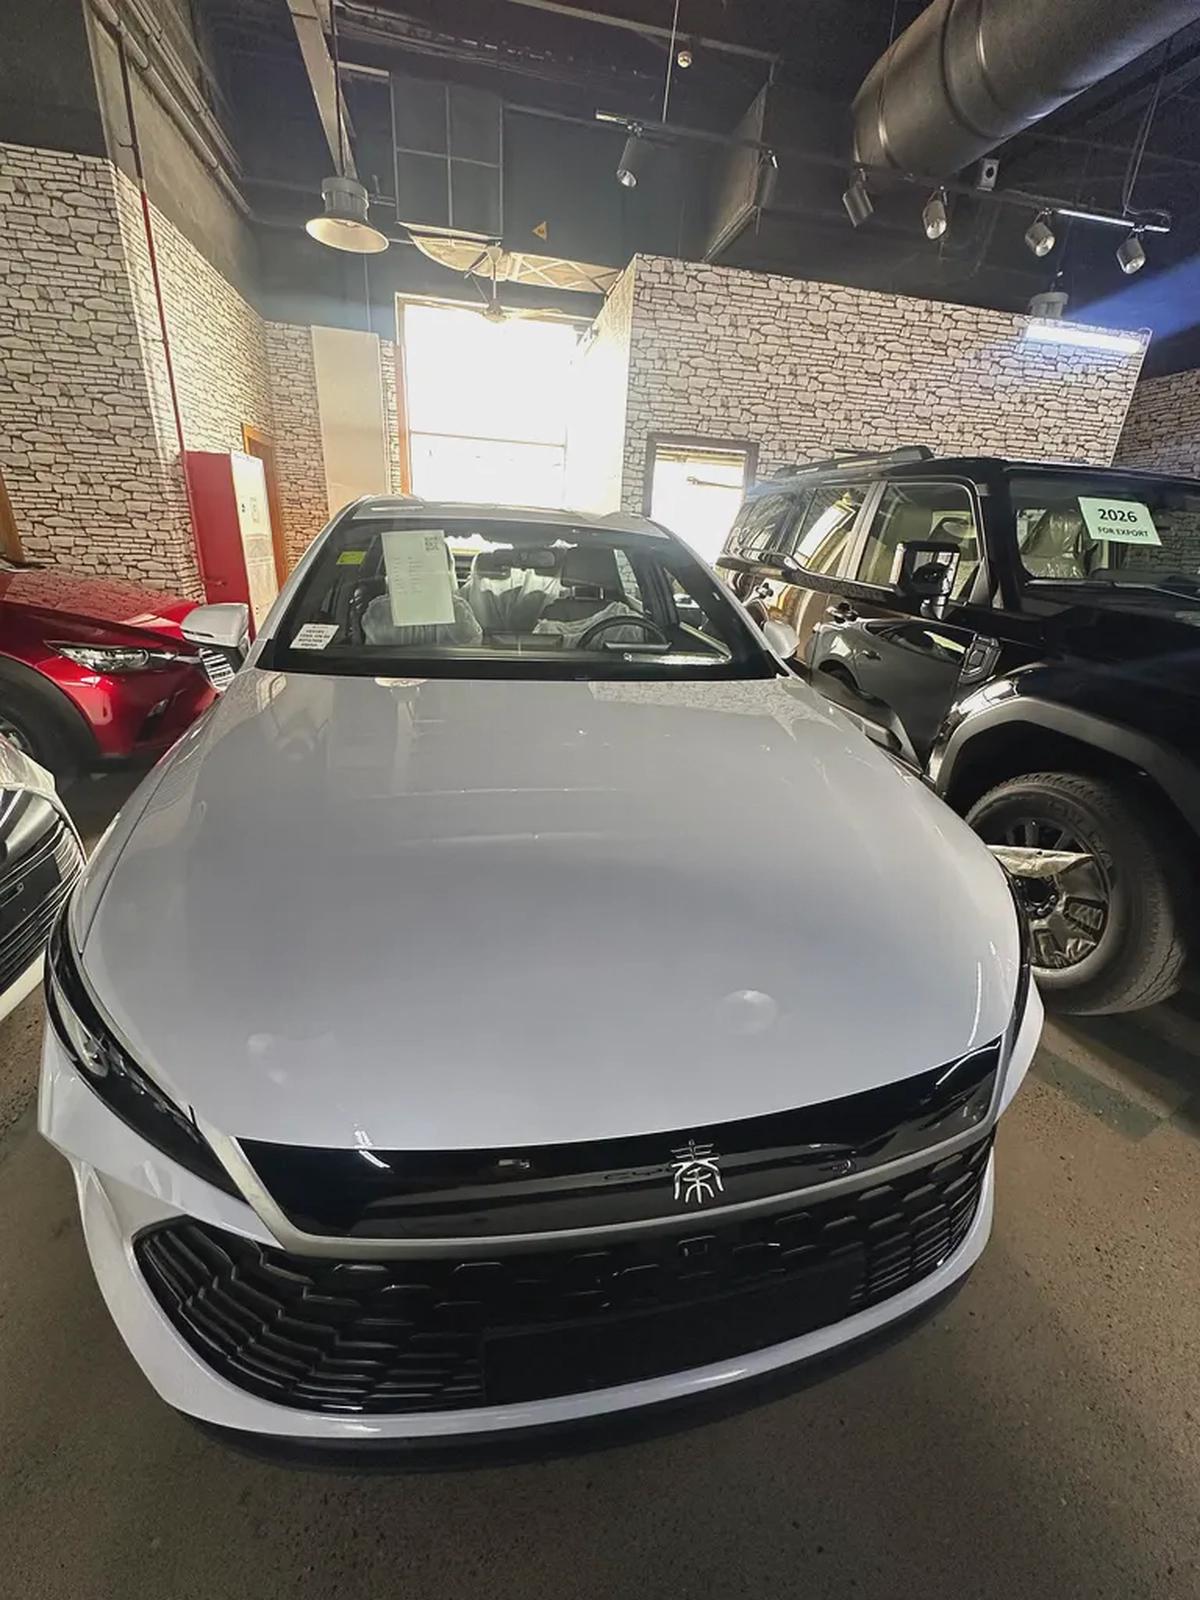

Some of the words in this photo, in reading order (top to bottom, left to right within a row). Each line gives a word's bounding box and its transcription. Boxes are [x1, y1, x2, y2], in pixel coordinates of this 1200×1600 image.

[1098, 508, 1138, 523] 2026
[1098, 526, 1115, 535] FOR
[1116, 527, 1149, 537] EXPORT
